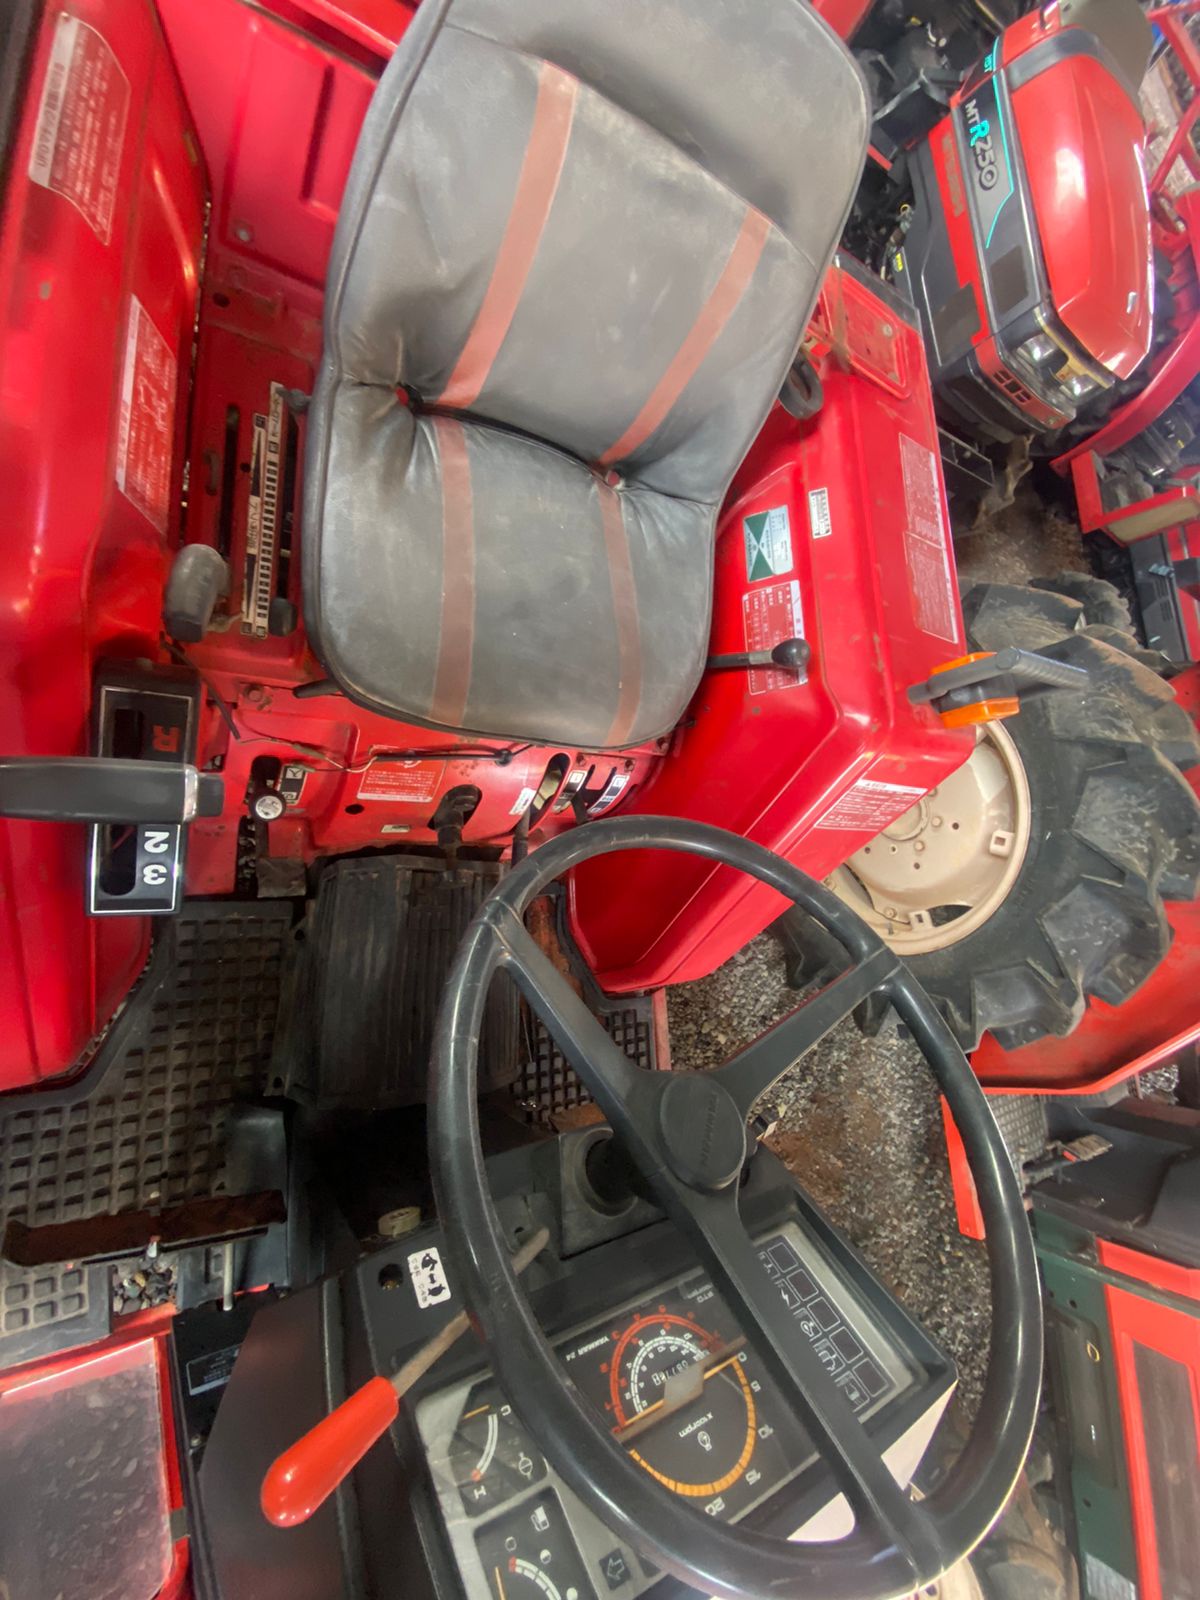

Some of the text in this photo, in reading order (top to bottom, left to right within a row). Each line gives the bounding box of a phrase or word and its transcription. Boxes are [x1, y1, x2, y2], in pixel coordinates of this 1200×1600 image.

[965, 98, 999, 189] MTR250
[152, 725, 180, 752] R
[143, 831, 169, 853] 2
[142, 864, 168, 885] 3
[577, 1335, 609, 1356] YANMAR
[738, 1352, 747, 1363] 0
[750, 1380, 761, 1393] 5
[500, 1404, 511, 1416] C
[757, 1423, 774, 1440] 10
[745, 1469, 762, 1486] 15
[473, 1485, 487, 1500] H
[704, 1496, 726, 1516] 20
